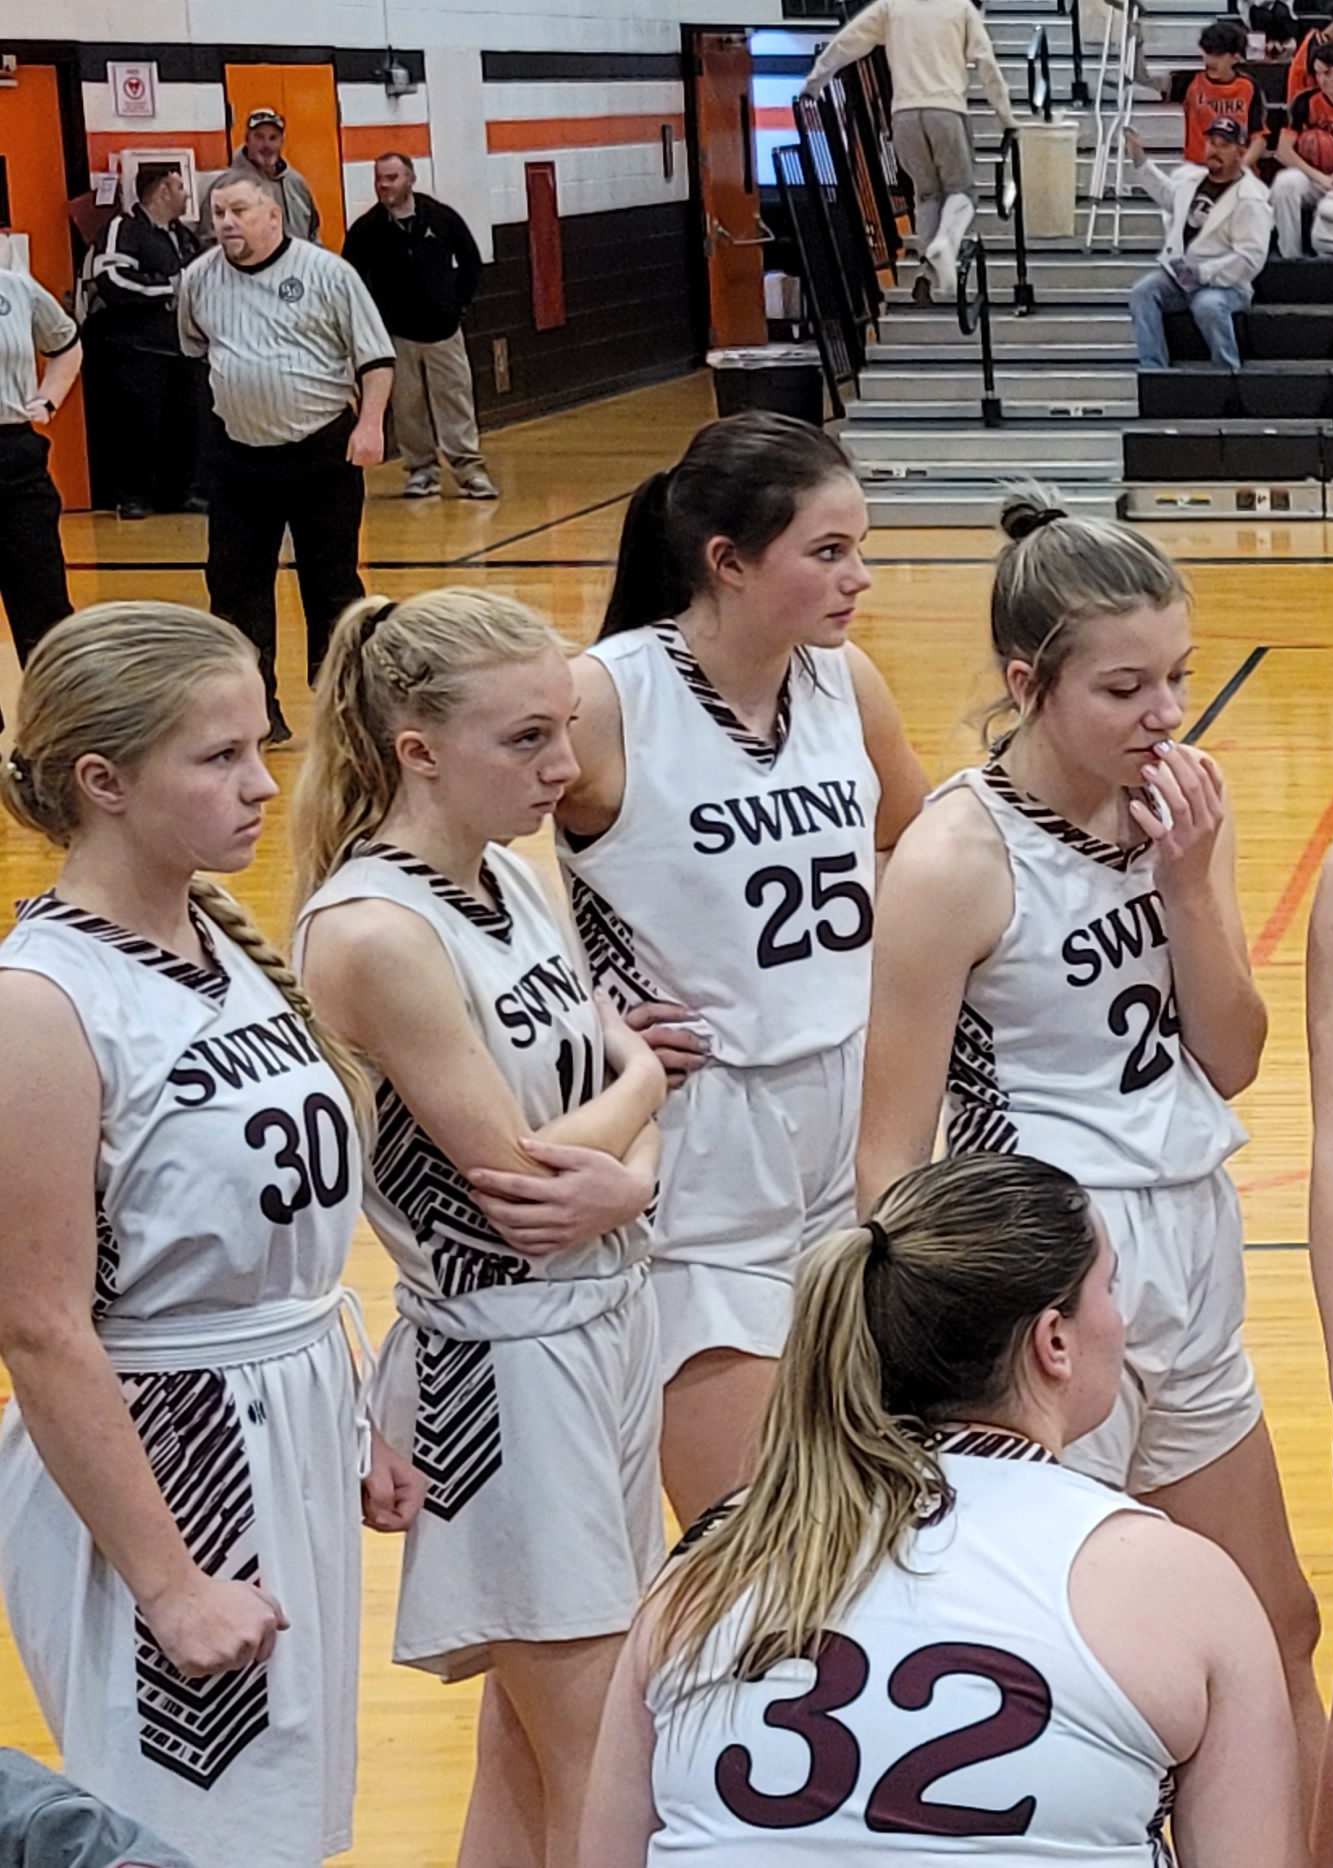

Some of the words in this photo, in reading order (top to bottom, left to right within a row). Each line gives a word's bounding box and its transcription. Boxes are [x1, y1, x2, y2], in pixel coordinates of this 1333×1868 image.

[690, 780, 865, 855] SWINK
[744, 852, 874, 970] 25
[244, 1092, 350, 1226] 30
[714, 1629, 1054, 1837] 32
